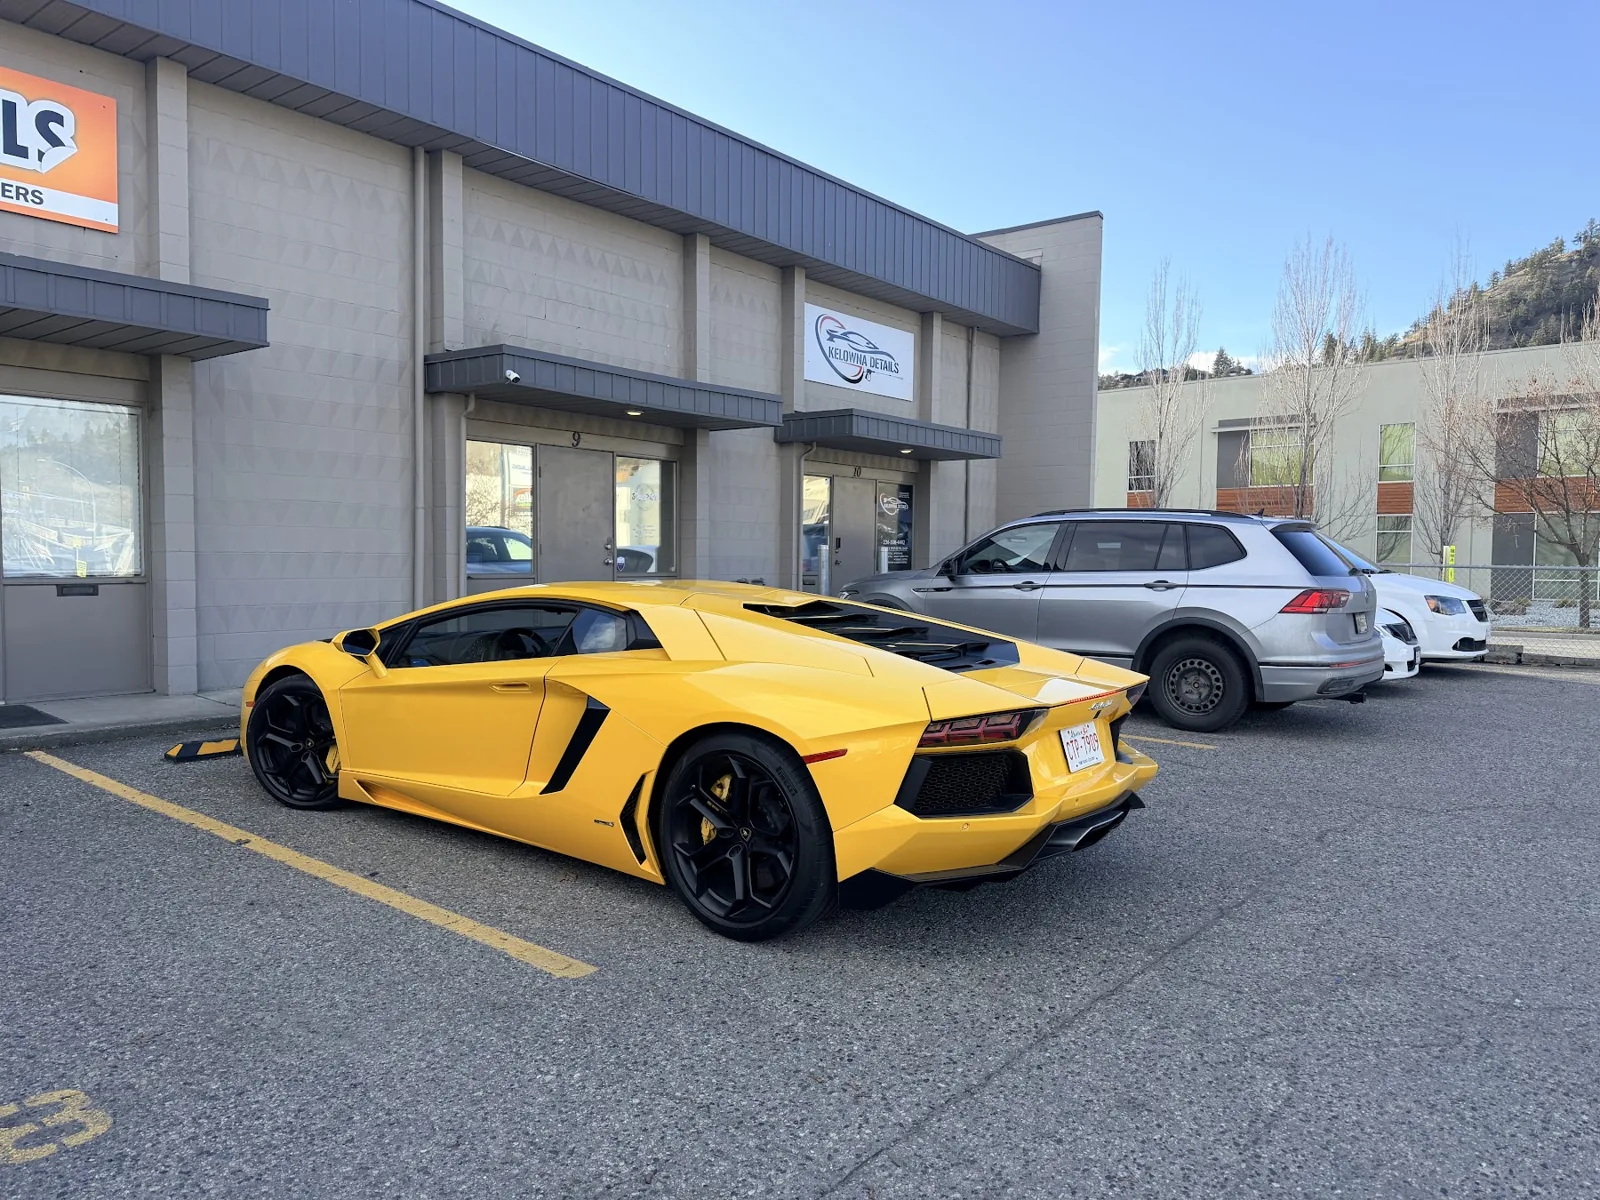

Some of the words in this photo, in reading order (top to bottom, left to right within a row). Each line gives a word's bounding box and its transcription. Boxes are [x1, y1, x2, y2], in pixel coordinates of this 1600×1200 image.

[1, 182, 44, 205] ERS
[828, 346, 867, 367] KELOWNA
[869, 356, 900, 374] DETAILS
[571, 430, 581, 448] 9
[853, 465, 862, 478] 10
